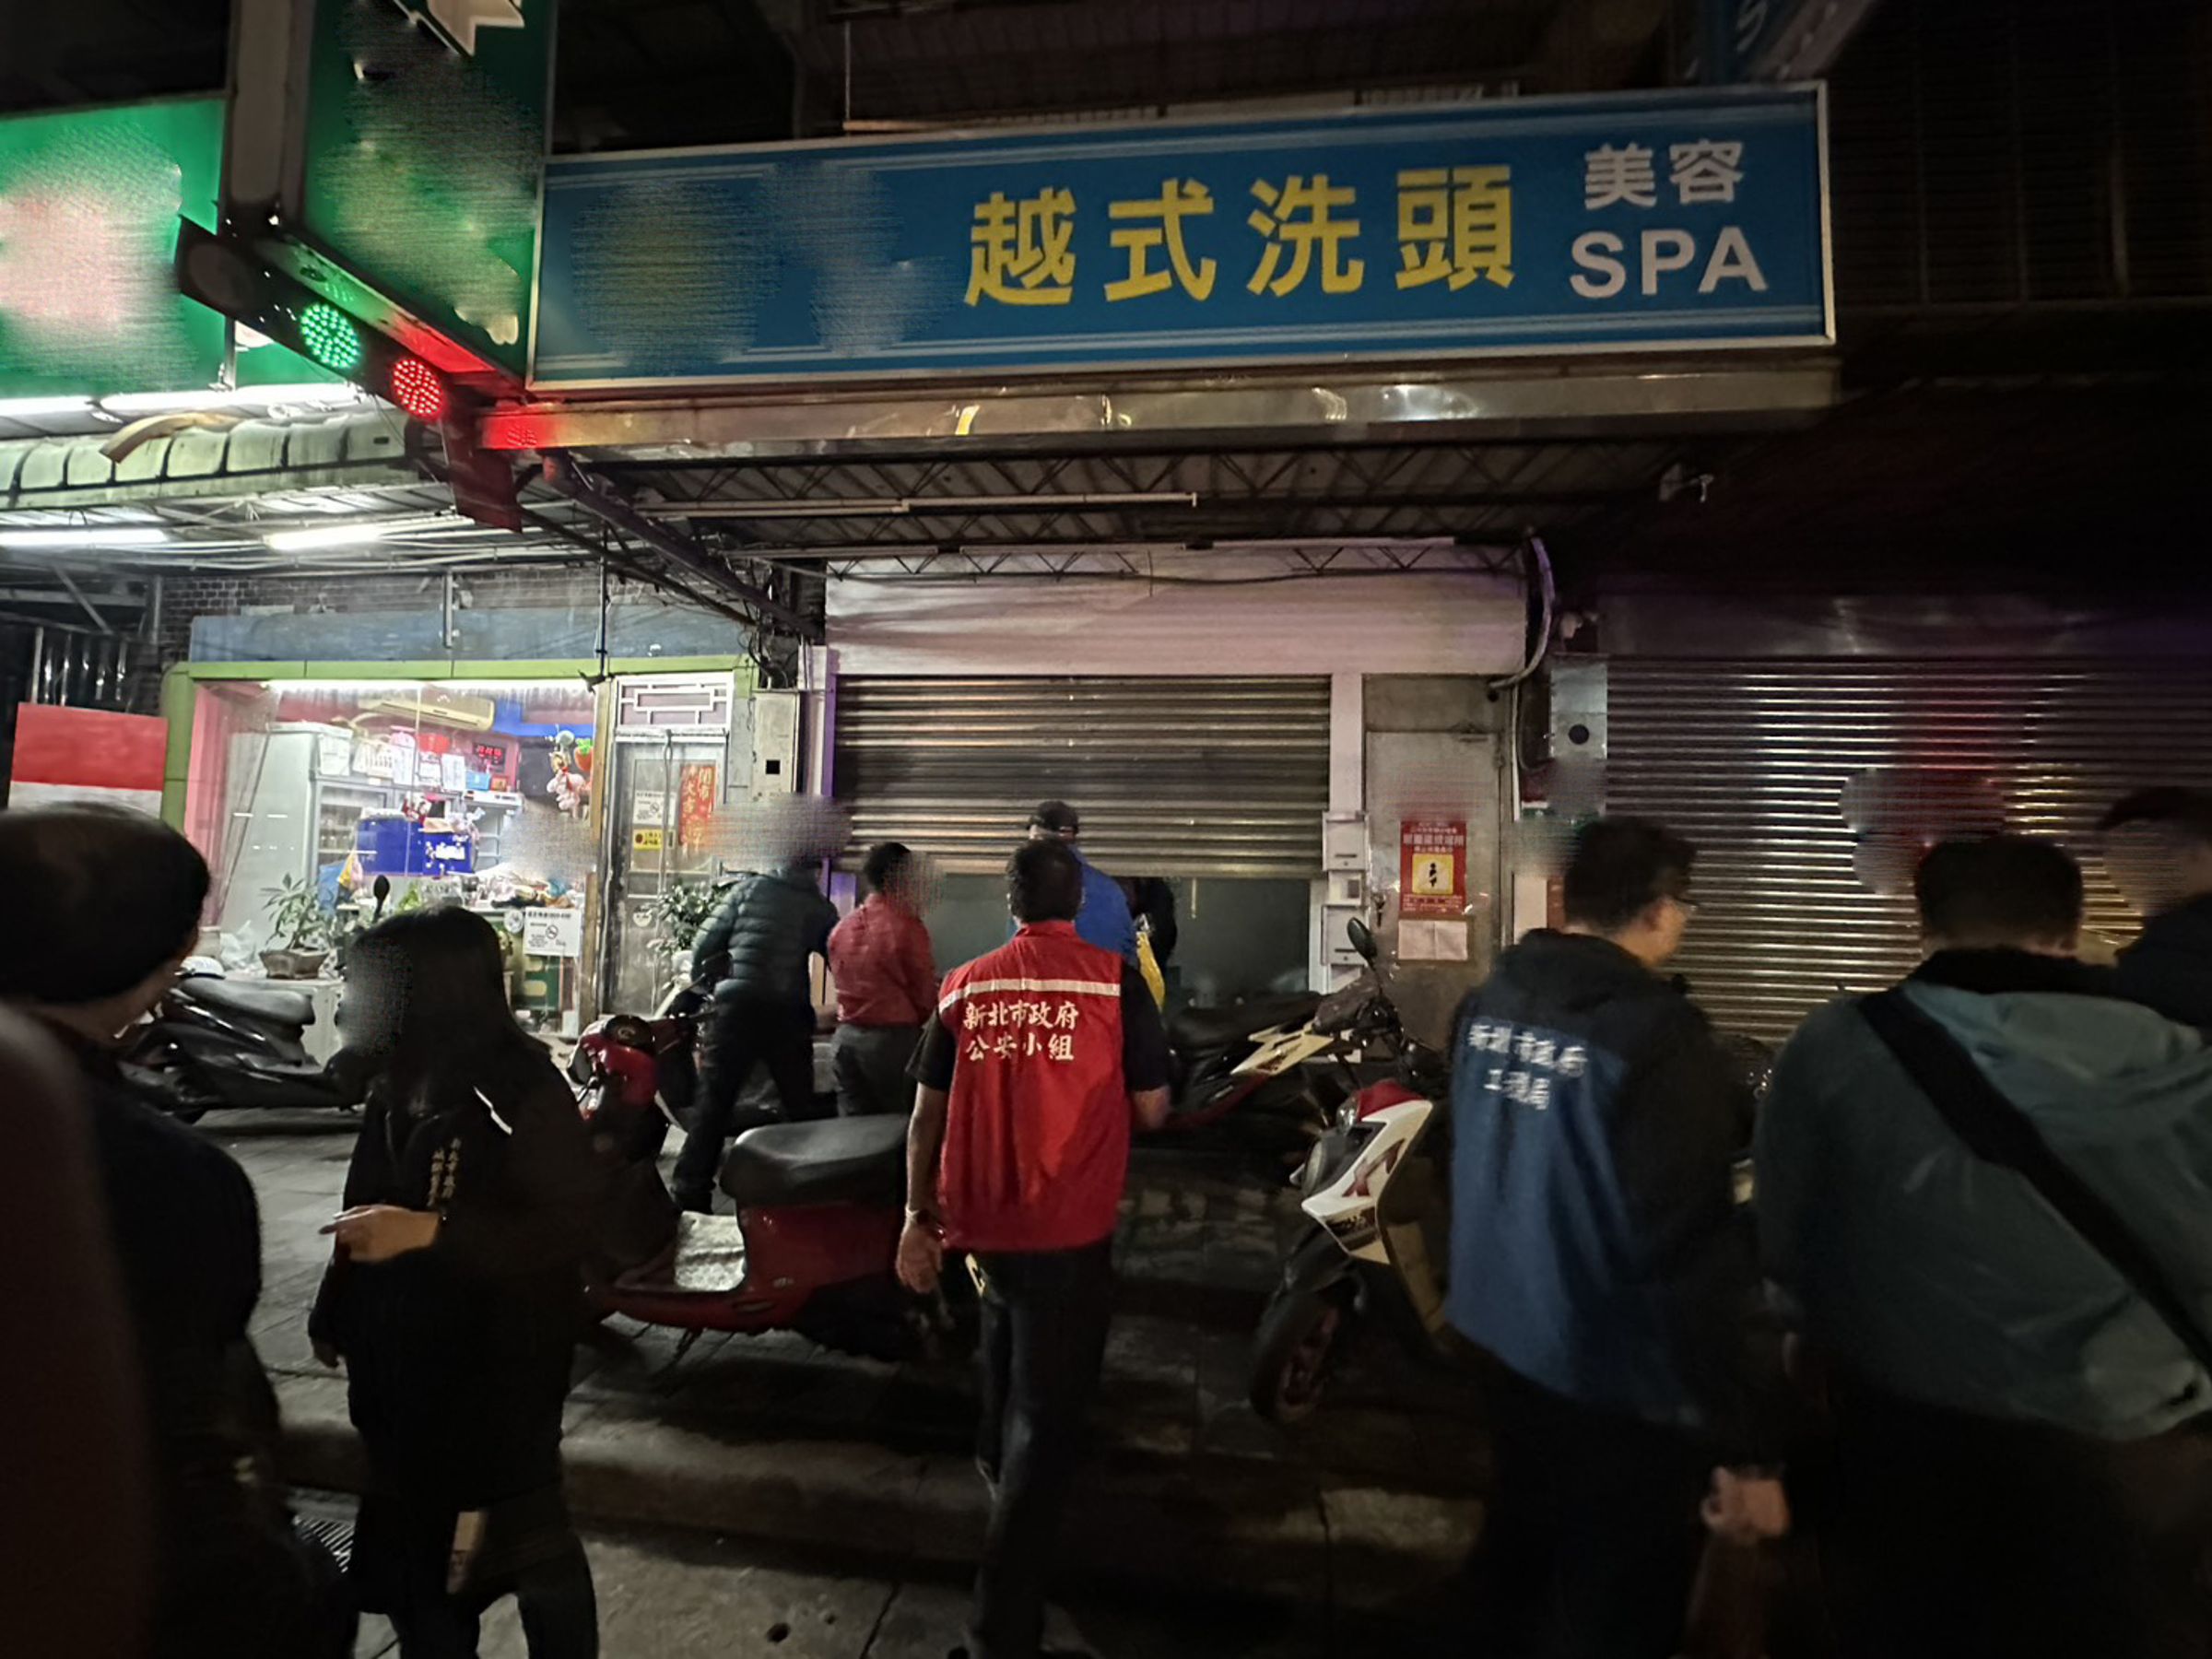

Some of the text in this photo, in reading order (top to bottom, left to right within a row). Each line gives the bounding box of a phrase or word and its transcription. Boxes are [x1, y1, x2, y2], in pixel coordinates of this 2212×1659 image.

[1584, 140, 1744, 210] 美容
[965, 165, 1514, 307] 越式洗頭
[1569, 228, 1767, 299] SPA
[962, 999, 1079, 1030] 新北市政府
[965, 1031, 1075, 1061] 公安小組
